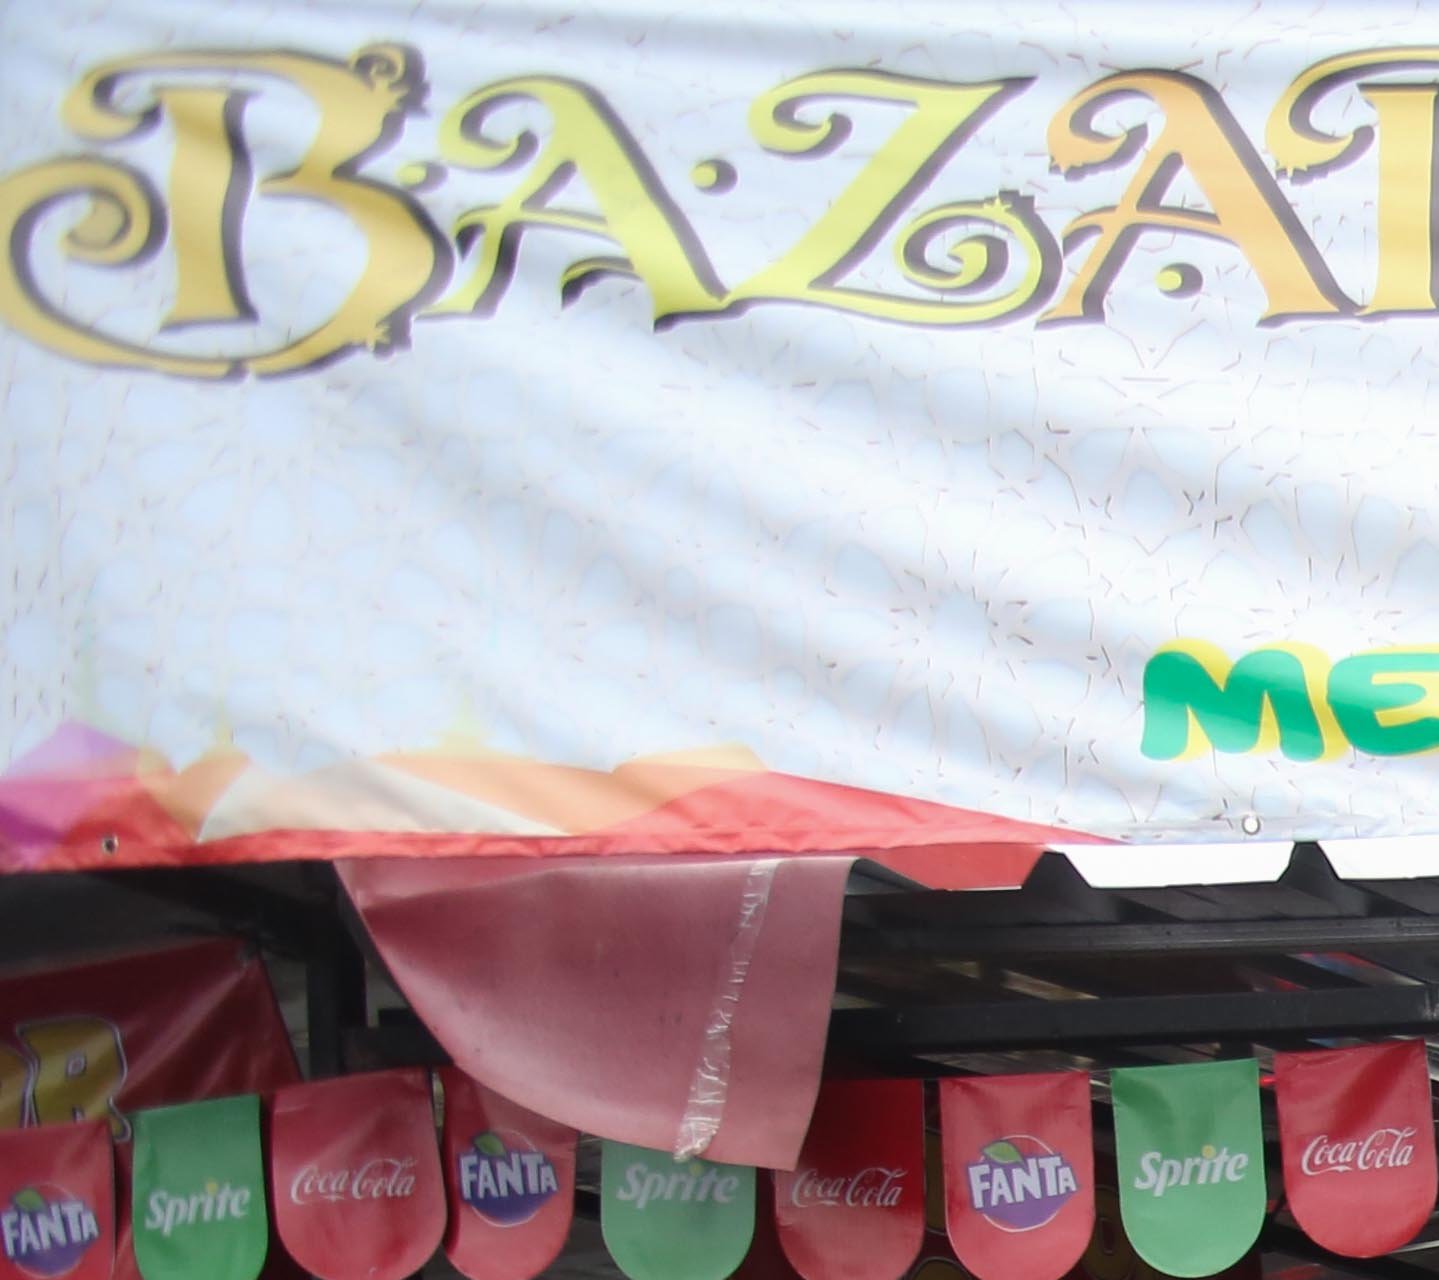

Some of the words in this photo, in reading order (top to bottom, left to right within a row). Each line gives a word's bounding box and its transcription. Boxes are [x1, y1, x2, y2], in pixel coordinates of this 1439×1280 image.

[459, 1152, 559, 1200] FANTA
[618, 1160, 741, 1211] Sprite
[968, 1153, 1078, 1210] FANTA
[1134, 1144, 1249, 1197] Sprite
[1, 1197, 99, 1262] FANTA
[145, 1180, 251, 1237] Sprite
